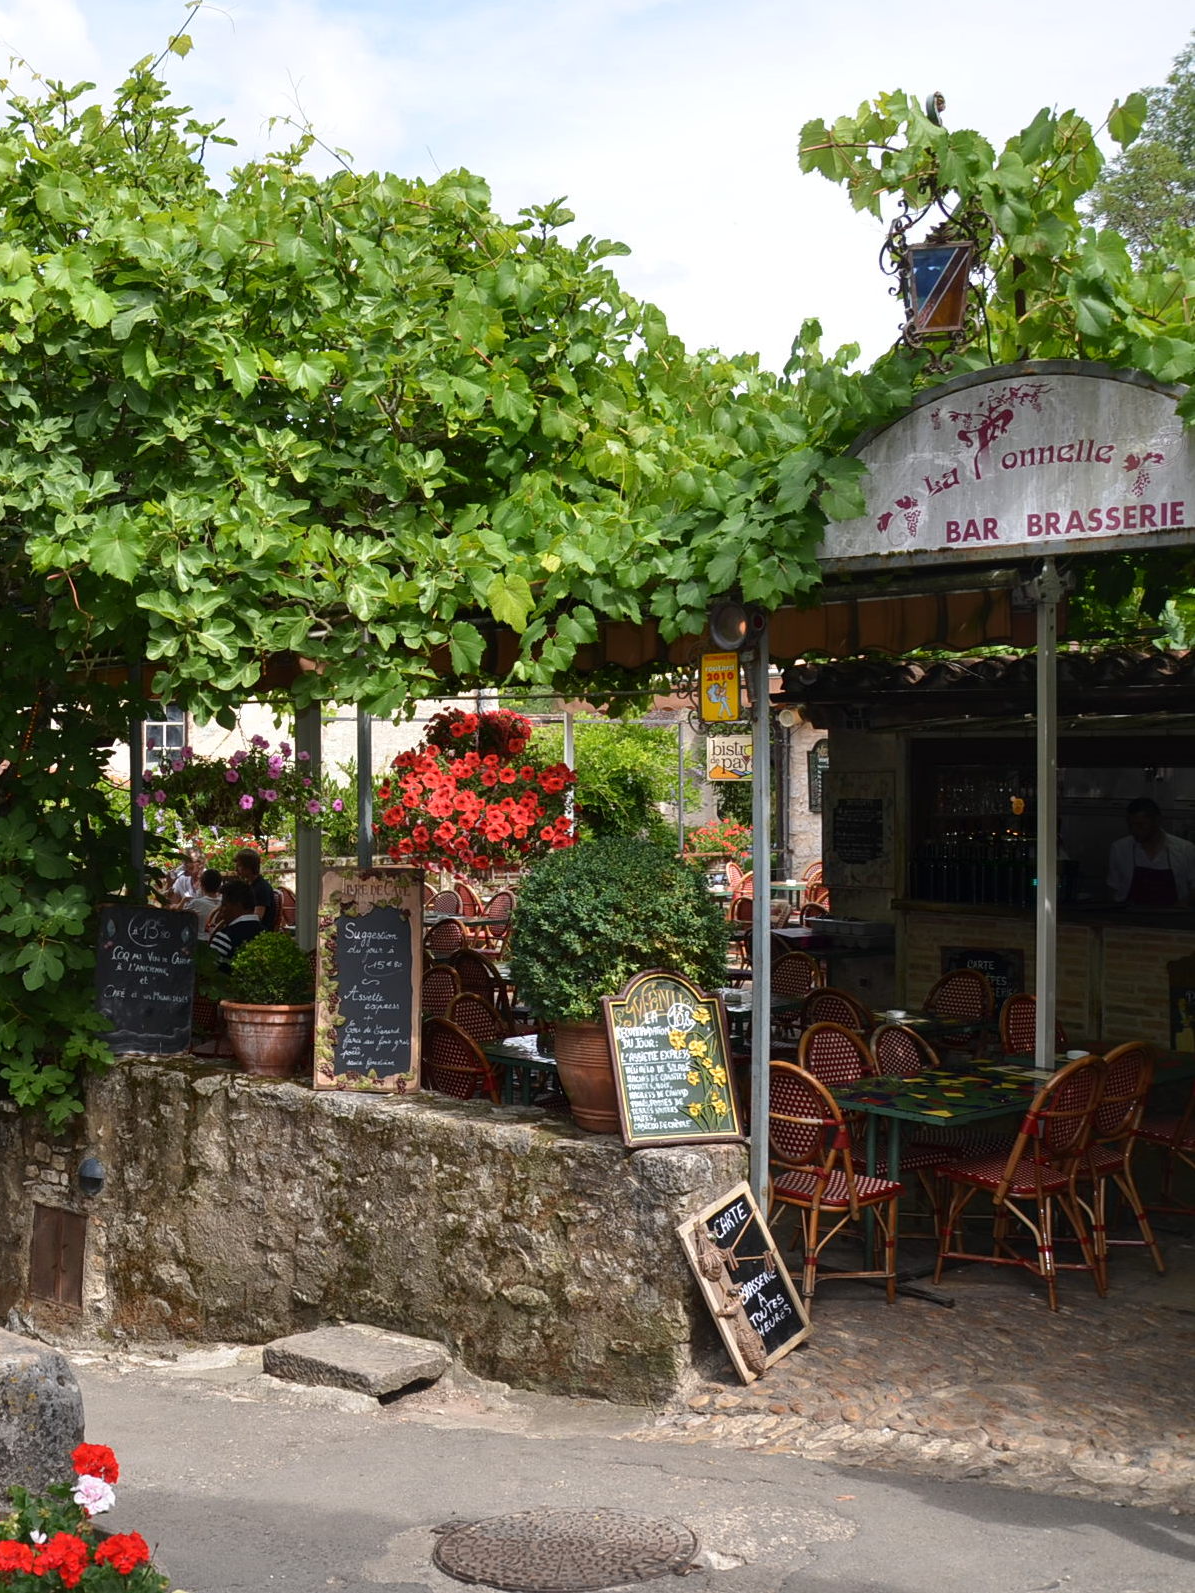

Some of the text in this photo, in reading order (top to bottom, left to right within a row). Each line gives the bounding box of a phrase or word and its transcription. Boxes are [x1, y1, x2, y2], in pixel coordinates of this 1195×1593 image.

[922, 468, 960, 497] La
[946, 501, 1185, 543] BAR BRASSERIE
[707, 672, 734, 681] 2010
[721, 756, 753, 774] pay
[344, 922, 398, 947] Suggestion
[347, 945, 361, 953] du
[967, 959, 995, 970] CARTE
[139, 976, 149, 985] et
[344, 985, 385, 1001] Assiette
[364, 1003, 400, 1014] express
[644, 1010, 658, 1024] LA
[621, 1038, 634, 1050] DU
[714, 1201, 748, 1239] CARTE
[749, 1293, 785, 1328] TOUTES
